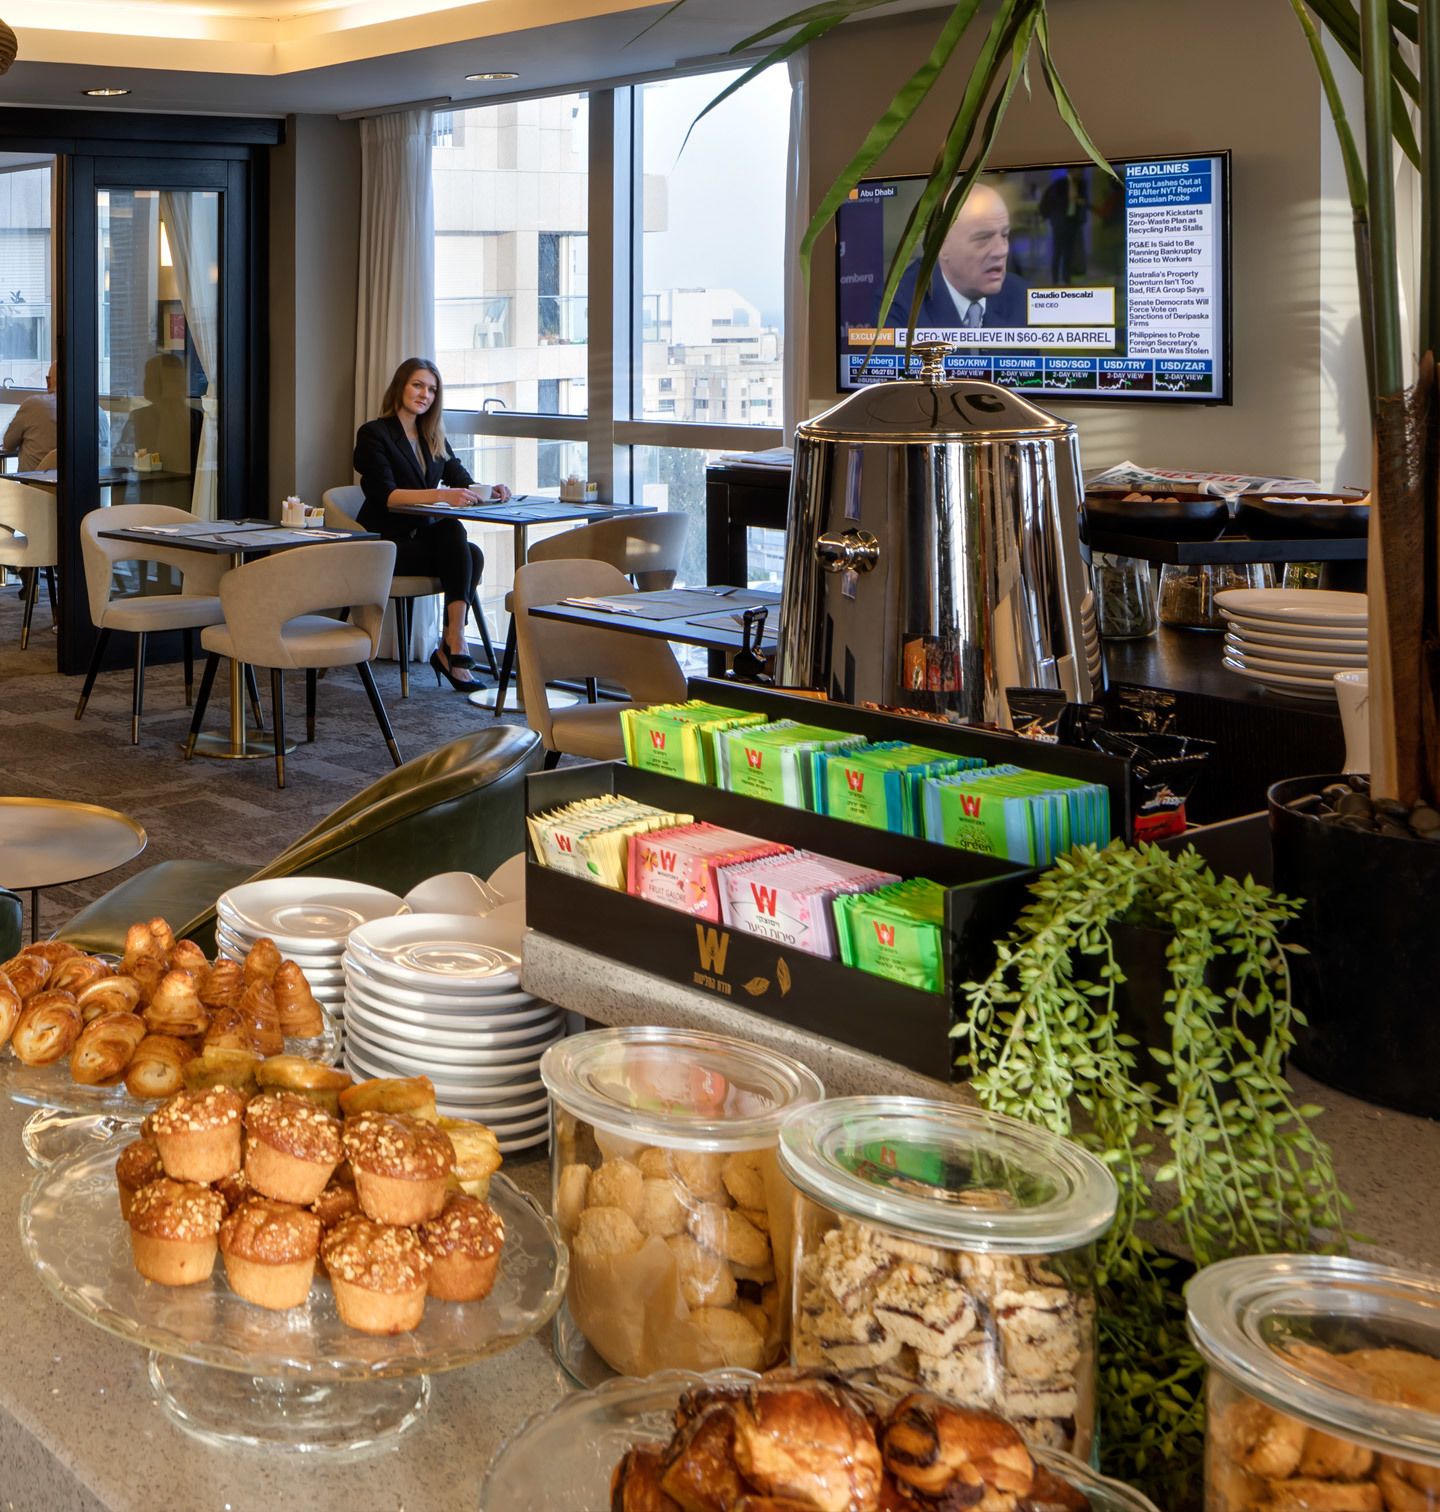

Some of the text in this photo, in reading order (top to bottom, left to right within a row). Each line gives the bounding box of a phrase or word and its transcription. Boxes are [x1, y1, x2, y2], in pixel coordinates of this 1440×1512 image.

[1126, 163, 1189, 176] HEADLINES
[874, 188, 894, 196] Dhabi
[1178, 186, 1202, 194] Report
[1139, 196, 1167, 204] Russian
[1168, 194, 1190, 202] Probe
[1128, 210, 1164, 219] Singapore
[1128, 218, 1170, 226] Zero-Waste
[1128, 226, 1163, 234] Recycling
[1182, 224, 1203, 232] Stalls
[1128, 248, 1202, 256] Planning Bankruptcy
[1128, 256, 1152, 264] Notice
[1166, 270, 1198, 278] Property
[1162, 286, 1185, 294] Group
[1186, 286, 1204, 294] Says
[942, 332, 958, 342] WE
[960, 332, 1002, 342] BELIEVE
[1004, 332, 1015, 342] IN
[1016, 332, 1054, 342] $60-62
[1056, 332, 1064, 342] A
[1066, 332, 1112, 342] BARREL
[852, 356, 894, 366] Blomberg
[948, 358, 988, 367] USD/KRW
[1000, 360, 1036, 368] USD/INR
[1049, 360, 1091, 368] USD/SGD
[1104, 361, 1146, 369] USD/TRY
[1160, 362, 1206, 370] USD/ZAR
[960, 838, 992, 854] green
[696, 923, 730, 975] W
